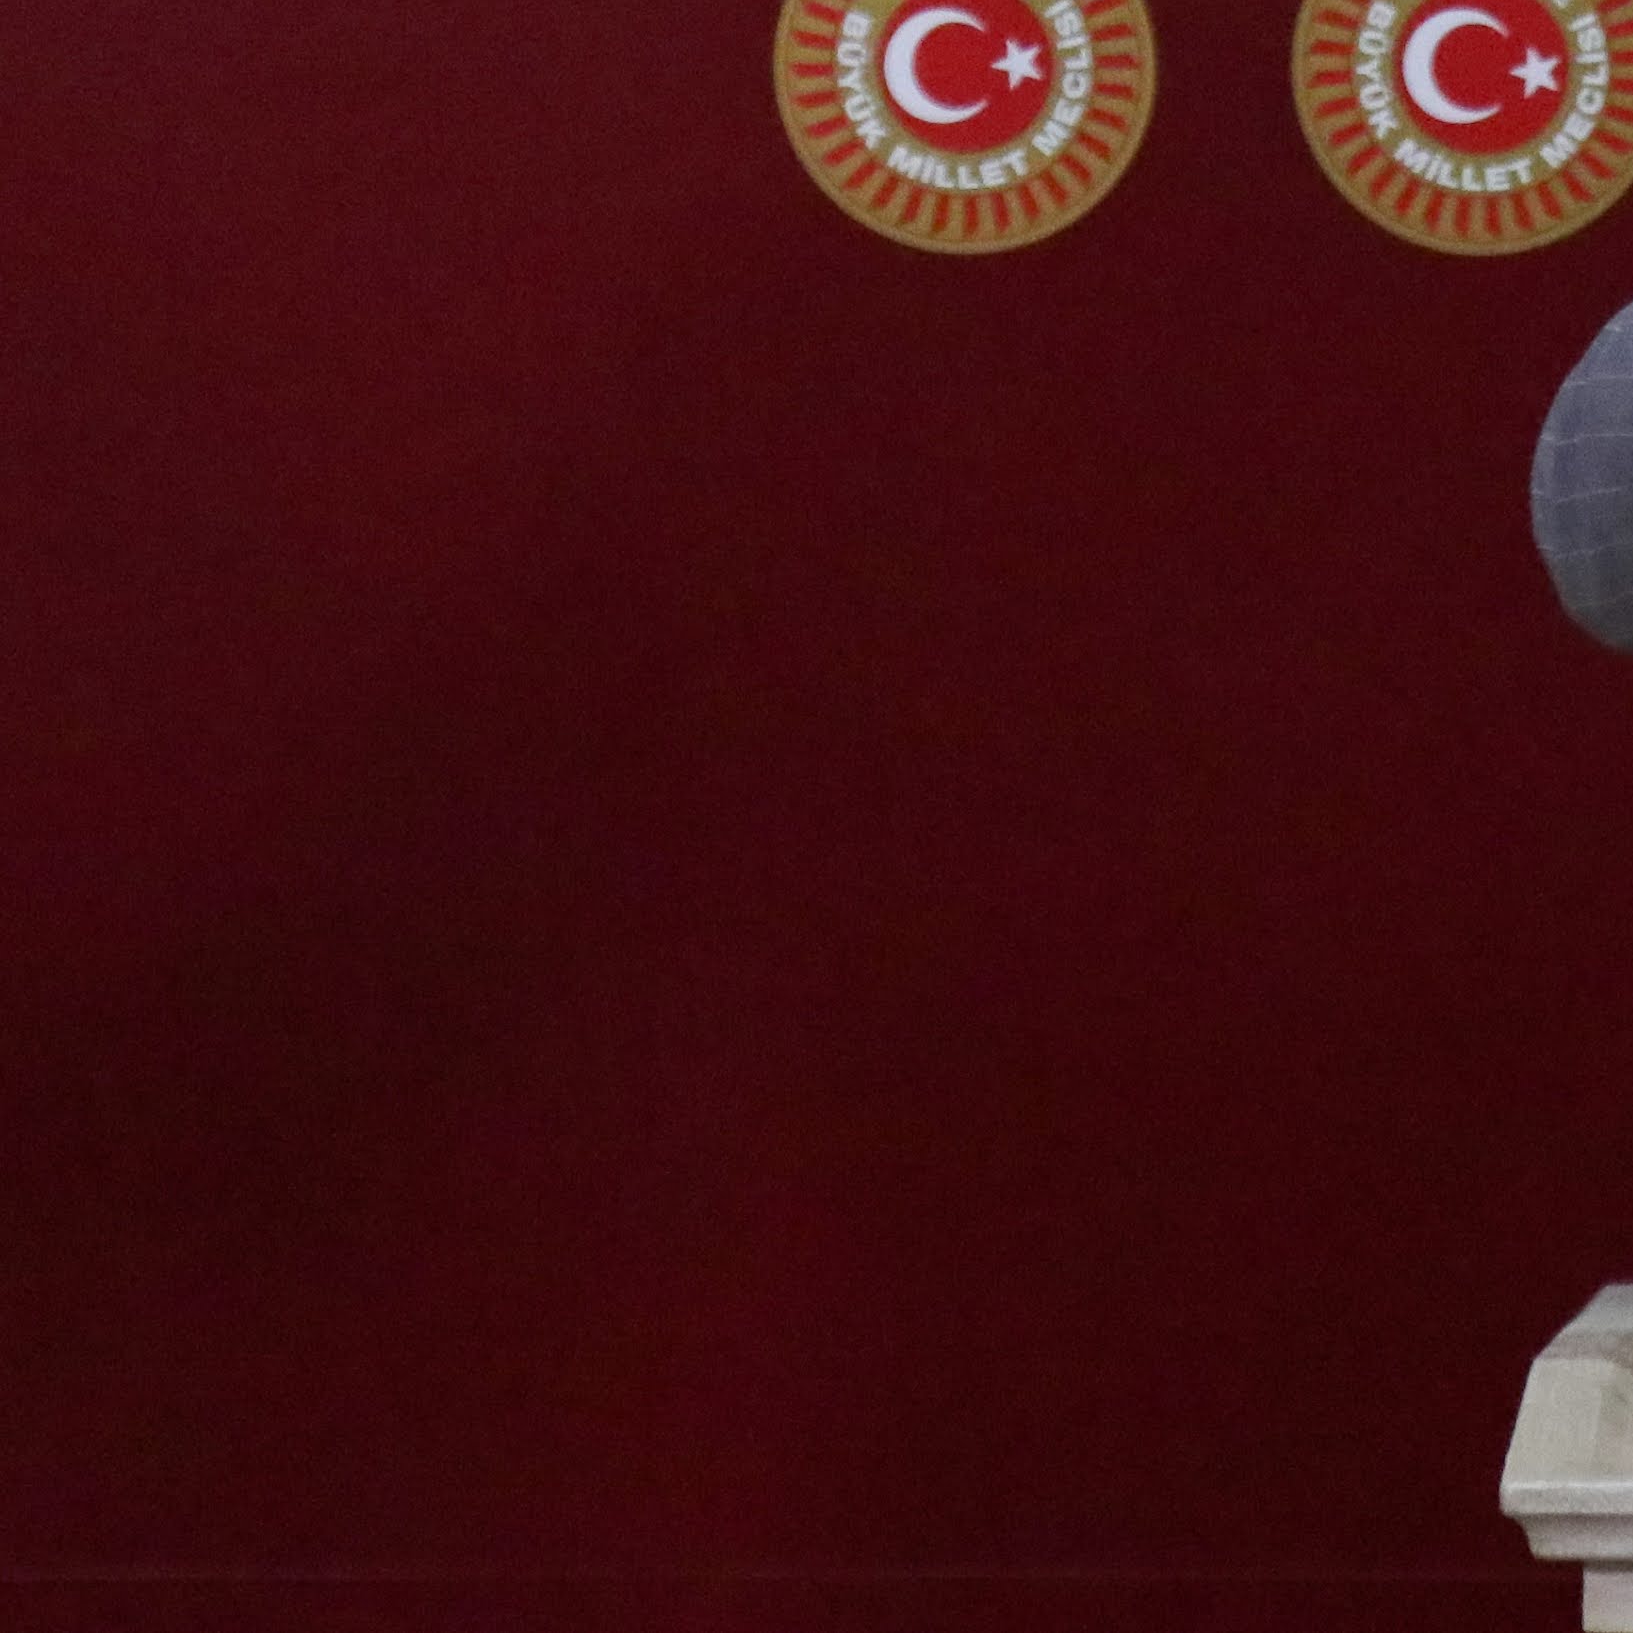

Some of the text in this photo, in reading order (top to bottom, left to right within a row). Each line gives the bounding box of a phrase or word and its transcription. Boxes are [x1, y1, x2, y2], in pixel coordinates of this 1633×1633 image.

[837, 9, 888, 150] BÜYÜK
[886, 145, 1028, 190] MİLLET
[1356, 0, 1397, 139] BÜYÜK
[1394, 137, 1534, 192] MİLLET
